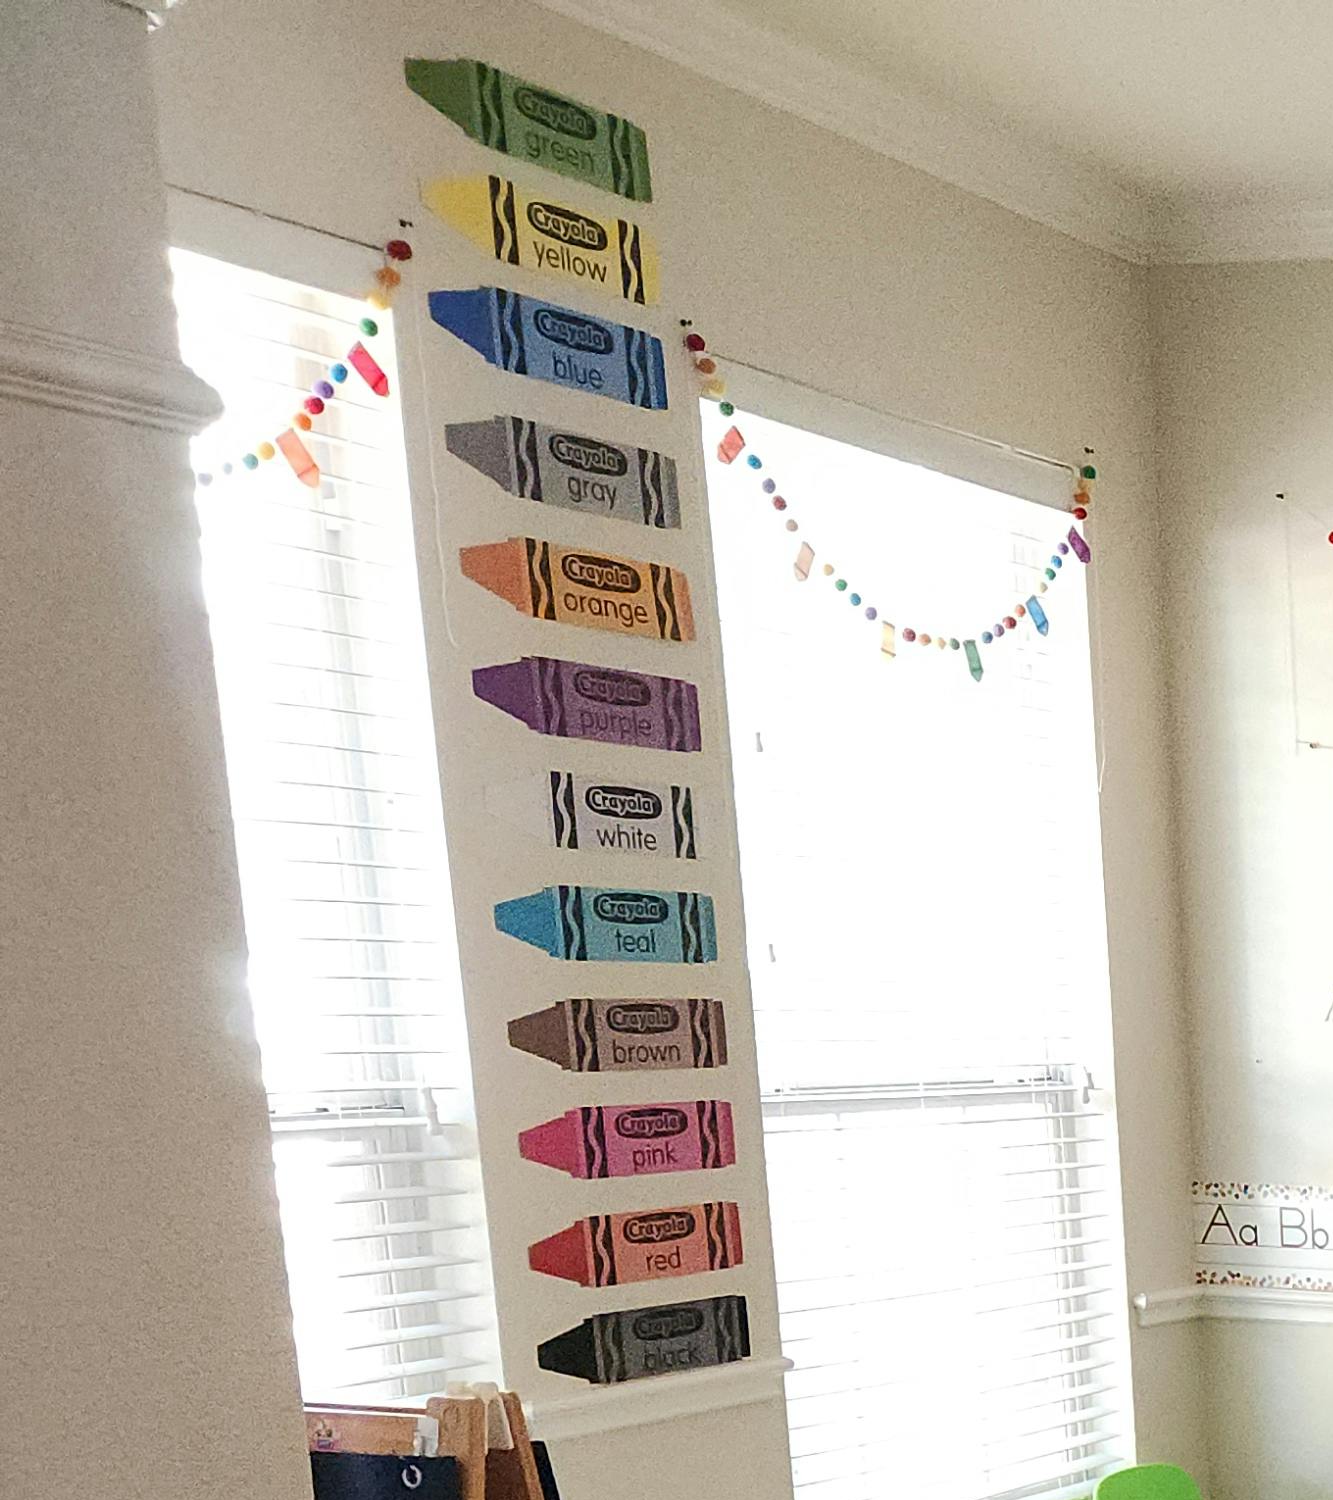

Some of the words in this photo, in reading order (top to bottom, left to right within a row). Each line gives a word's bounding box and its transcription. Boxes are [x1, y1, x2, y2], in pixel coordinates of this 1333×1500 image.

[517, 89, 589, 134] Crayola
[526, 132, 597, 177] green
[532, 204, 600, 244] Crayola
[533, 241, 607, 283] yellow
[538, 313, 606, 351] Crayola
[553, 352, 604, 389] blue
[553, 435, 620, 470] Crayola
[567, 476, 617, 510] gray
[566, 557, 631, 587] Crayola
[563, 592, 648, 627] orange
[577, 673, 642, 701] Crayola
[580, 709, 652, 740] purple
[591, 788, 655, 815] Crayola
[597, 824, 658, 851] white
[598, 897, 661, 920] Crayola
[615, 929, 656, 954] teal
[611, 1008, 671, 1031] Crayola
[613, 1038, 681, 1064] brown
[619, 1112, 680, 1134] Crayola
[633, 1142, 677, 1171] pink
[626, 1215, 687, 1240] Crayola
[1201, 1204, 1258, 1246] Aa
[1279, 1207, 1329, 1249] Bb
[646, 1247, 681, 1271] red
